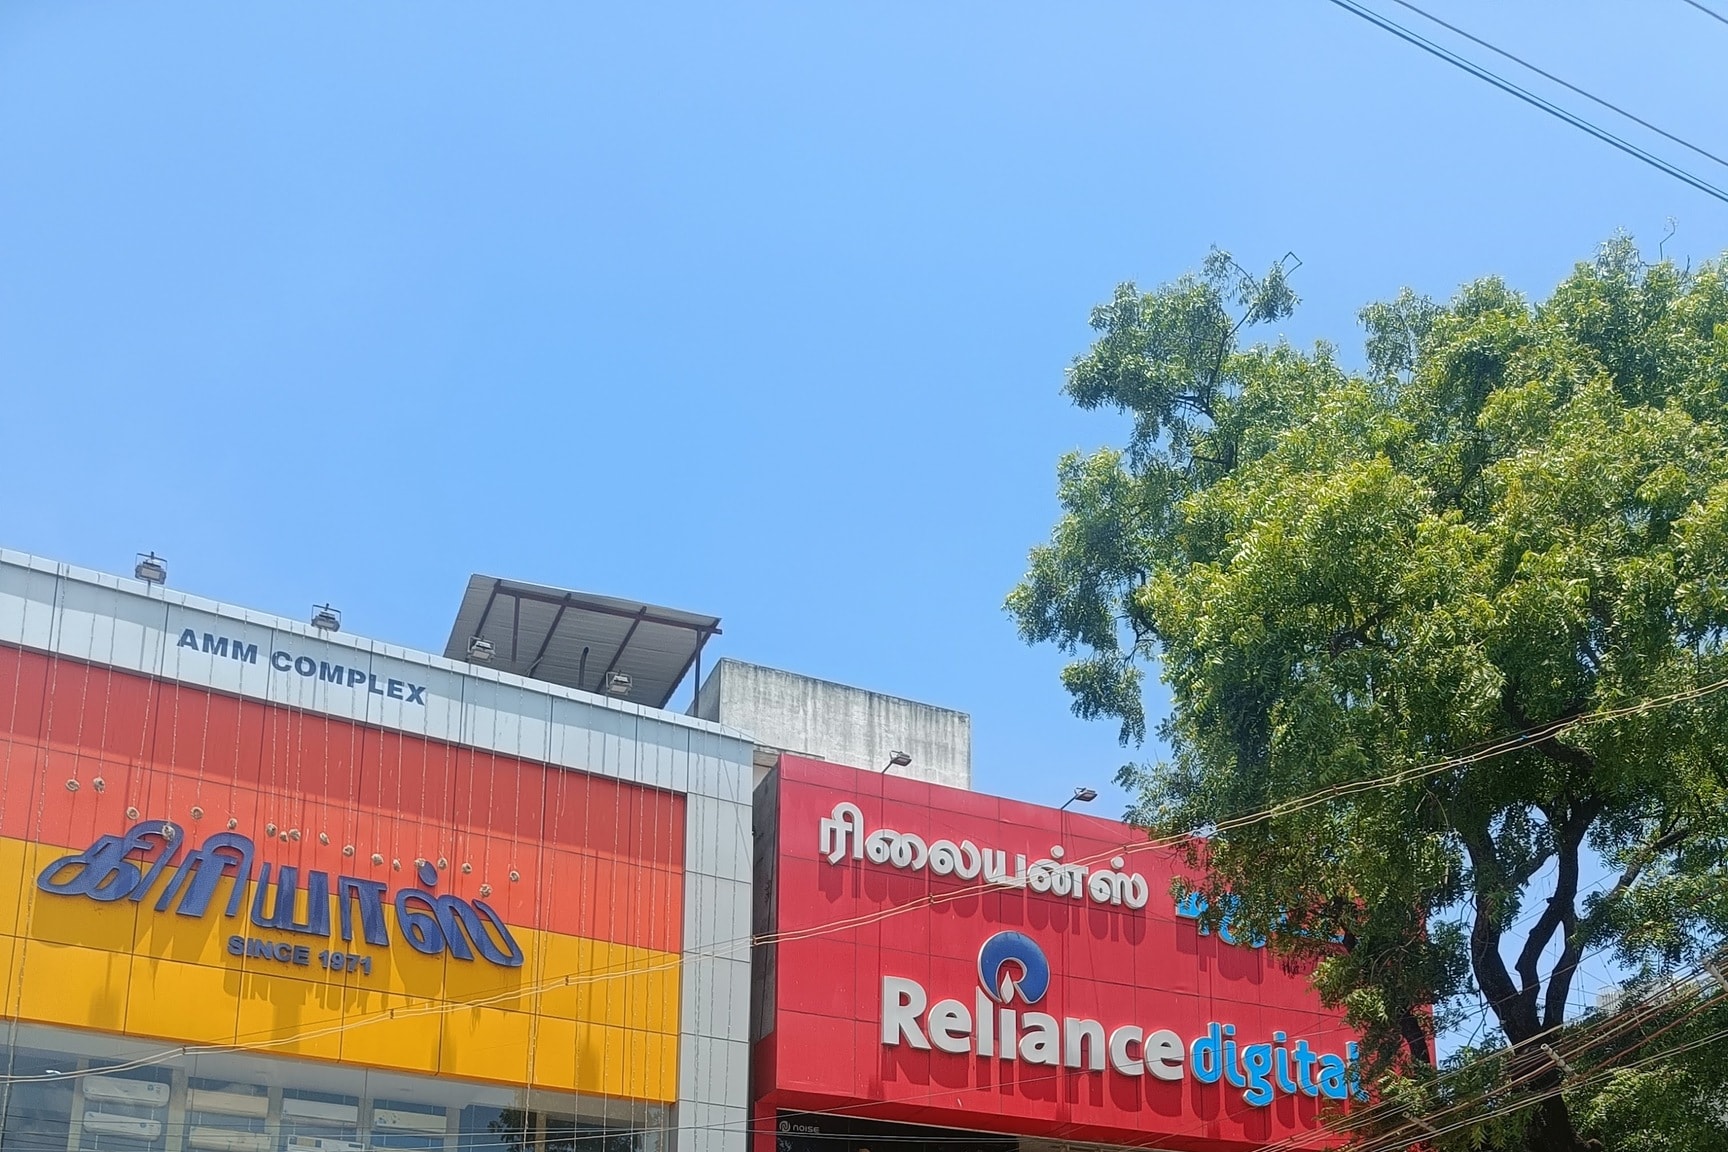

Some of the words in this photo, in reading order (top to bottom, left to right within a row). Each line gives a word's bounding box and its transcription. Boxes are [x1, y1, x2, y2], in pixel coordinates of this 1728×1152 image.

[177, 628, 258, 665] AMM
[271, 650, 427, 706] COMPLEX
[36, 820, 525, 968] கிரியாஸ்
[819, 802, 1149, 910] ரிலையன்ஸ்
[227, 935, 310, 966] SINCE
[319, 950, 372, 975] 1971
